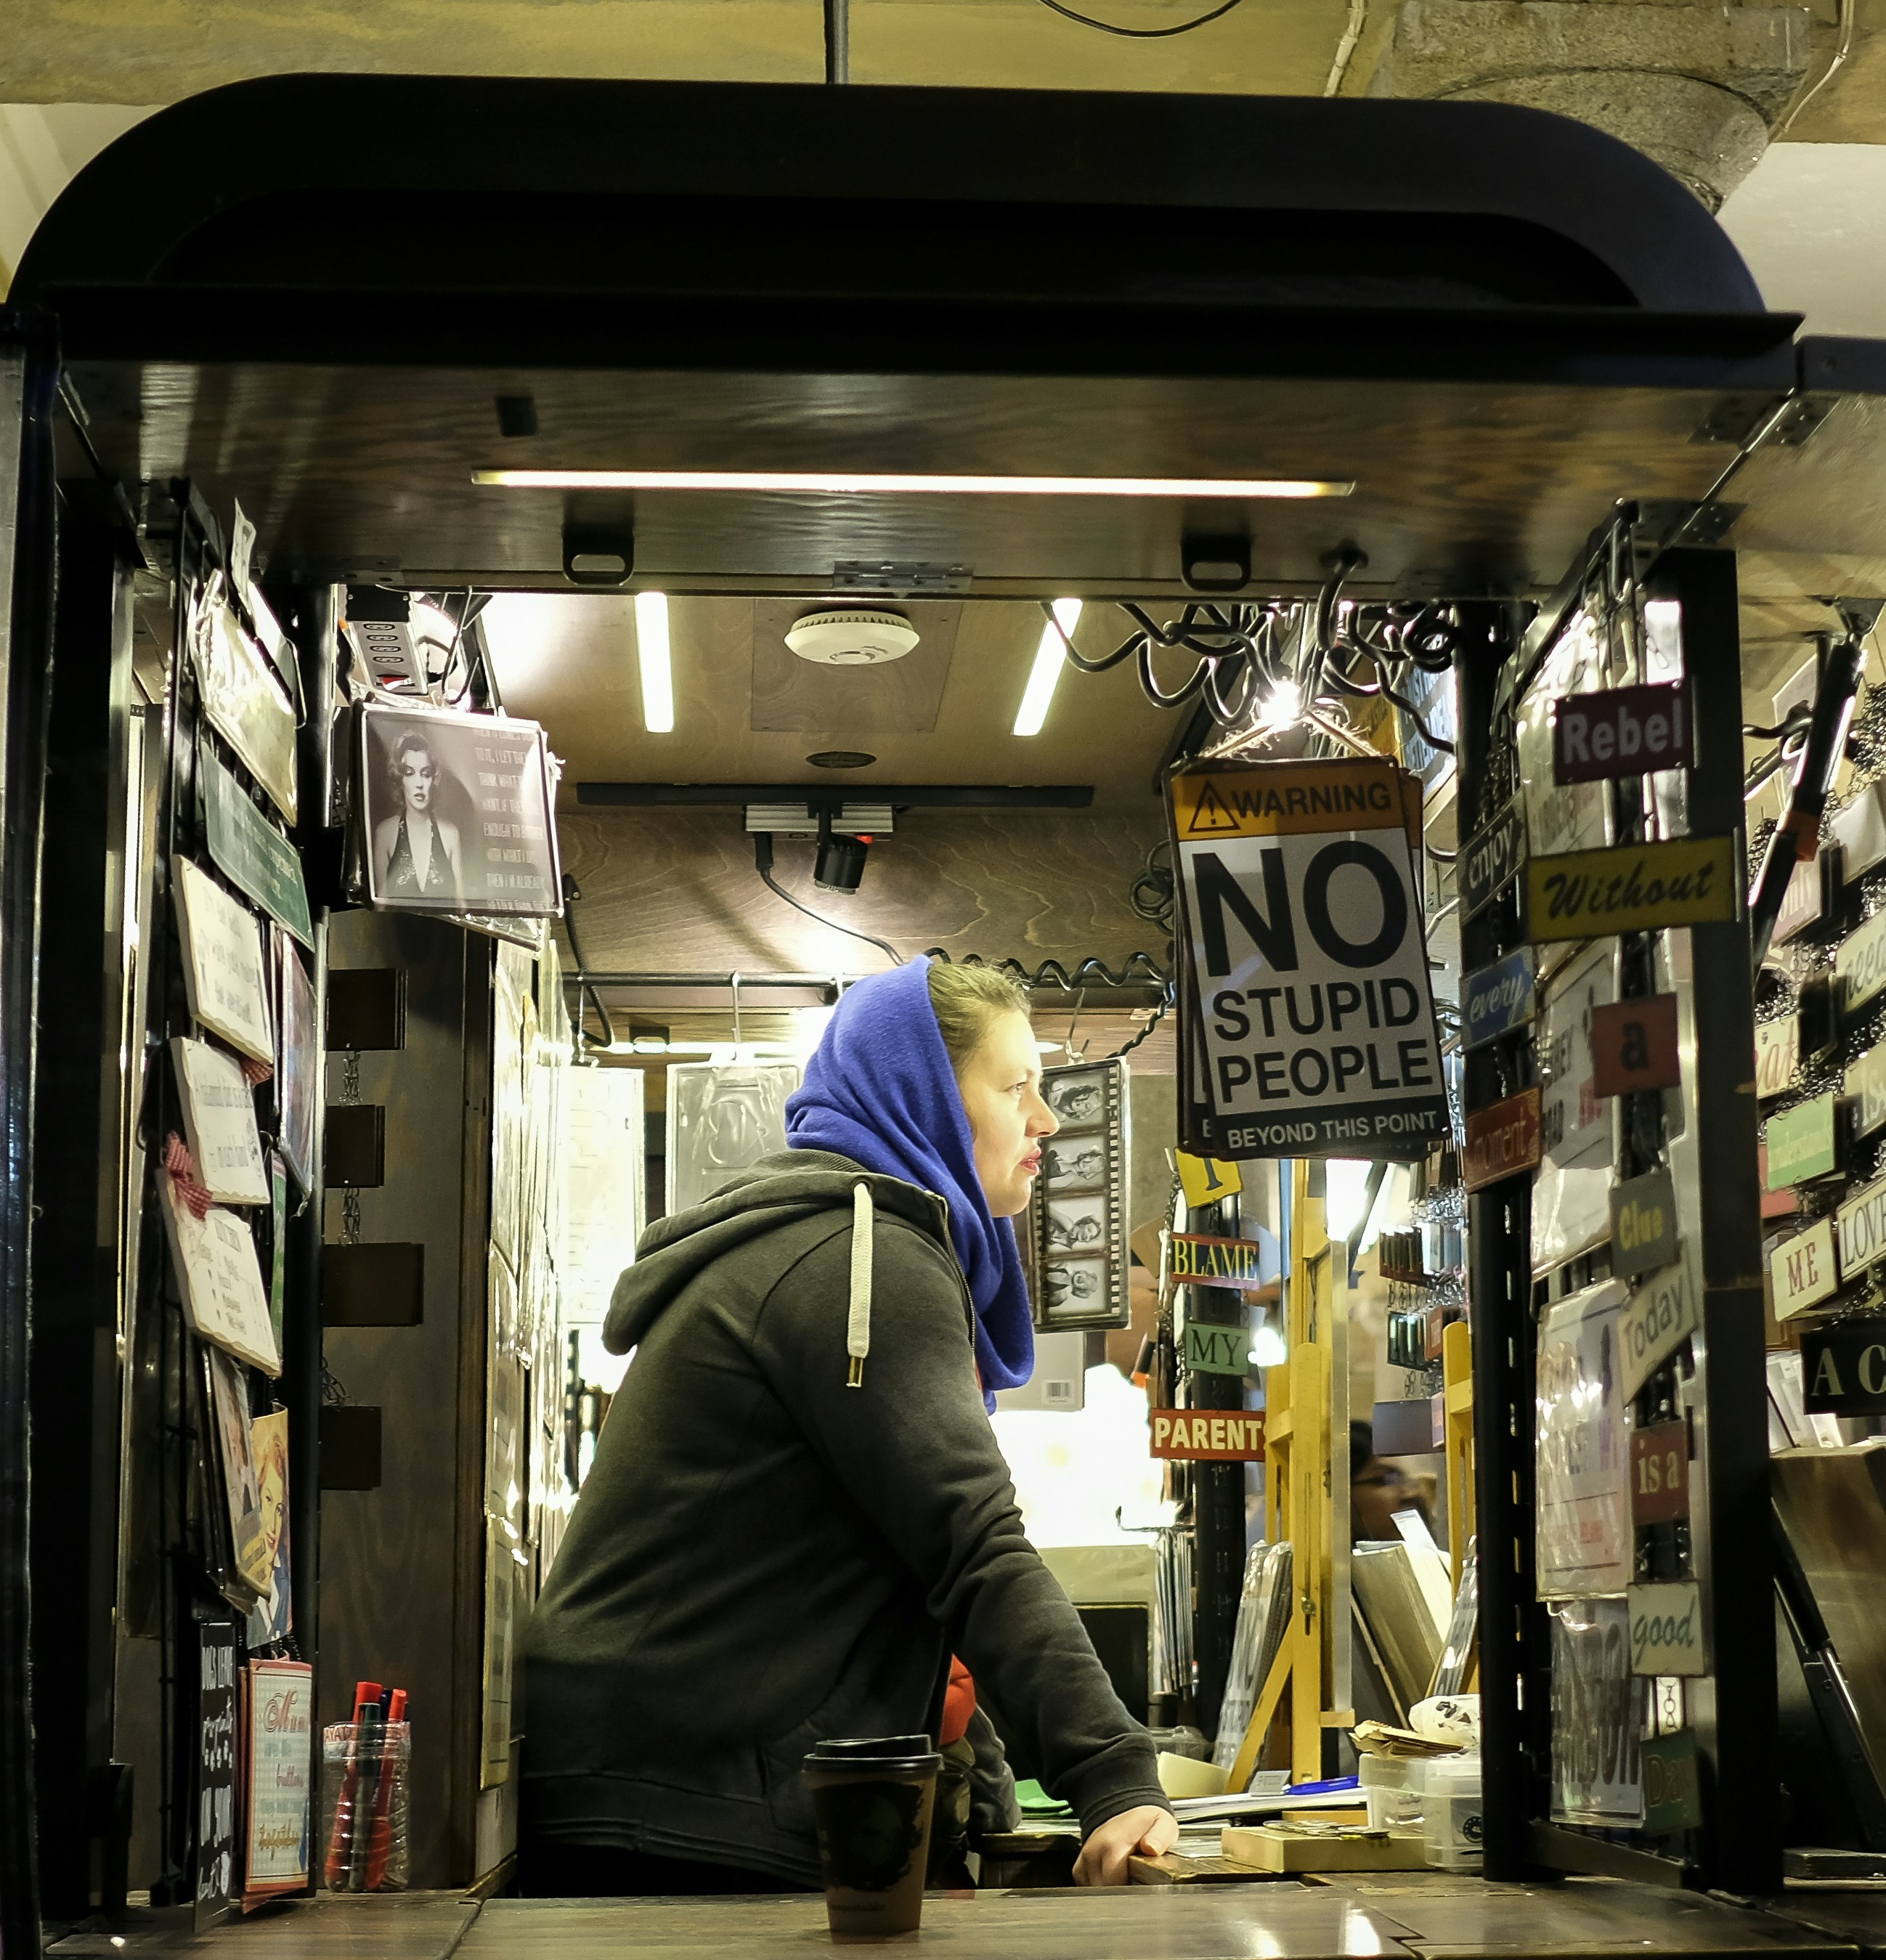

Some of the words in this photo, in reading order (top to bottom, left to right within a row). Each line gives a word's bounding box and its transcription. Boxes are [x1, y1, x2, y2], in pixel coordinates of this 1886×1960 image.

[1562, 697, 1683, 765] Rebel
[1231, 781, 1392, 820] WARNING
[1468, 818, 1513, 890] enjoy
[1192, 839, 1409, 977] NO
[1543, 859, 1715, 921] Without
[1212, 977, 1420, 1042] STUPID
[1469, 975, 1526, 1028] every
[1216, 1038, 1434, 1105] PEOPLE
[1620, 1021, 1650, 1072] a
[1227, 1121, 1317, 1150] BEYOND
[1320, 1116, 1370, 1140] THIS
[1375, 1110, 1437, 1134] POINT
[1173, 1239, 1258, 1280] BLAME
[1785, 1241, 1819, 1298] ME
[1190, 1328, 1242, 1367] MY
[1624, 1274, 1684, 1368] Today
[1155, 1417, 1266, 1452] PARENT
[1638, 1439, 1662, 1495] is
[1667, 1450, 1680, 1489] a
[1633, 1593, 1698, 1666] good
